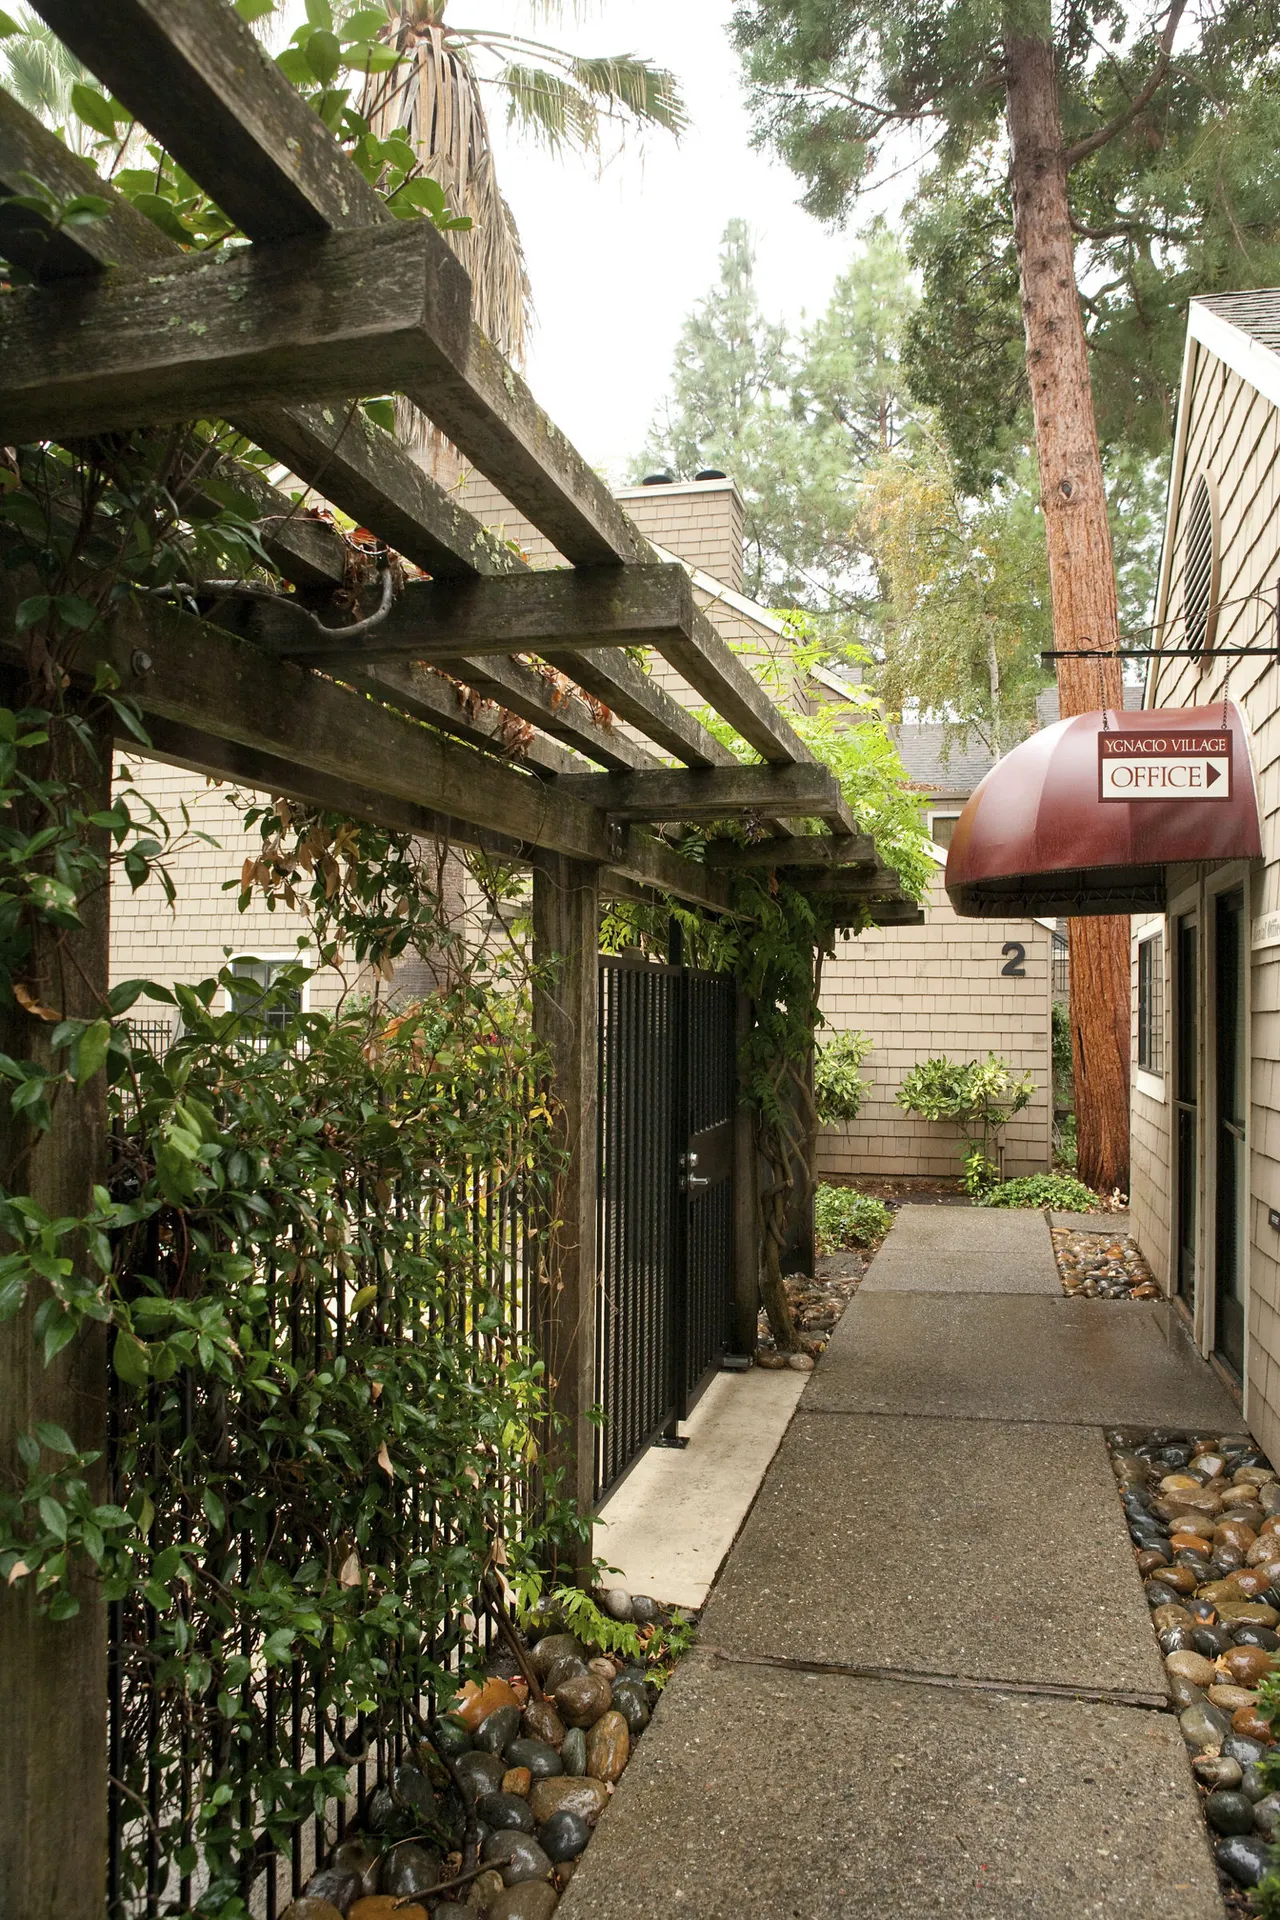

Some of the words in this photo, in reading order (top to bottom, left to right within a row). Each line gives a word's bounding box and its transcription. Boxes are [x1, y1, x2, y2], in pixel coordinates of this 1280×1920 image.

[1105, 739, 1167, 752] YGNACIO
[1171, 738, 1226, 751] VILLAGE
[1110, 765, 1202, 788] OFFICE
[1001, 941, 1026, 976] 2
